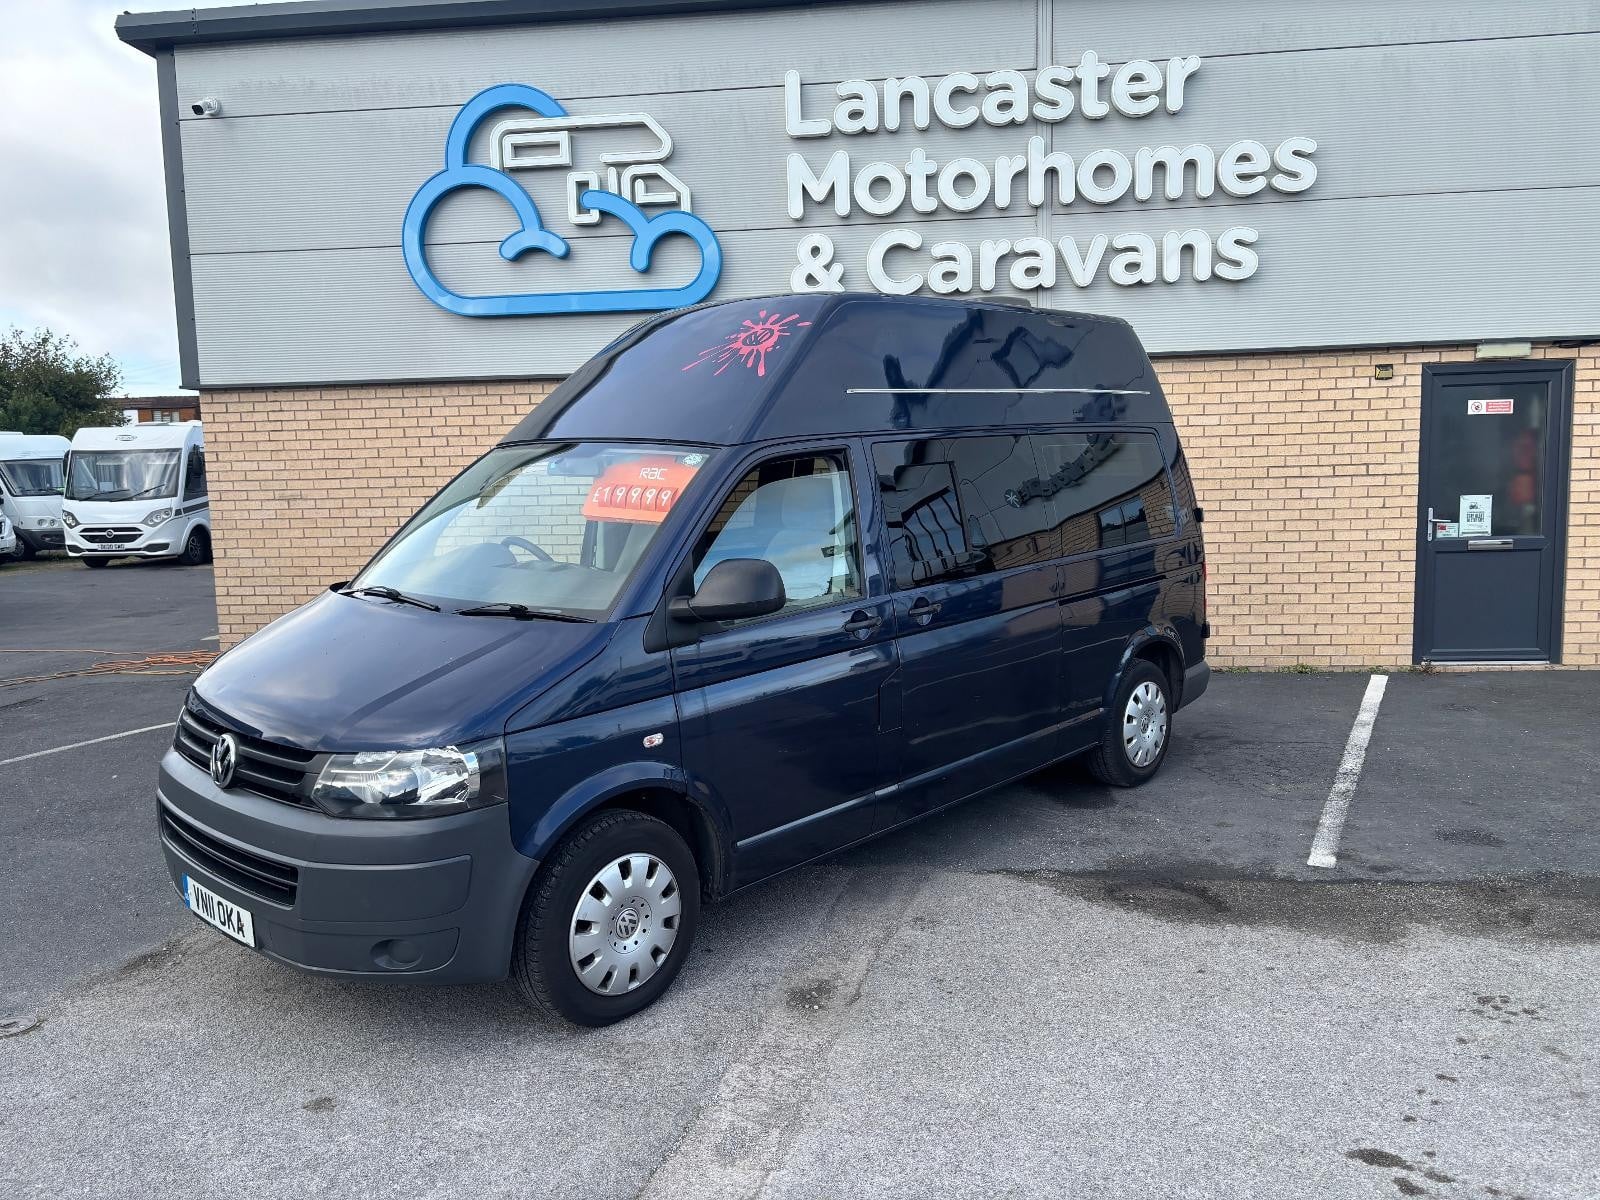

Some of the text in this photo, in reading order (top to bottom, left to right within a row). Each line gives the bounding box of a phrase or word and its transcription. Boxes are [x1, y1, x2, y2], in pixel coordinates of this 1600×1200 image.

[784, 50, 1201, 138] Lancaster
[786, 136, 1318, 220] Motorhomes
[790, 227, 1260, 295] & Caravans
[592, 486, 671, 507] £19999
[193, 884, 245, 938] VN11 OKA
